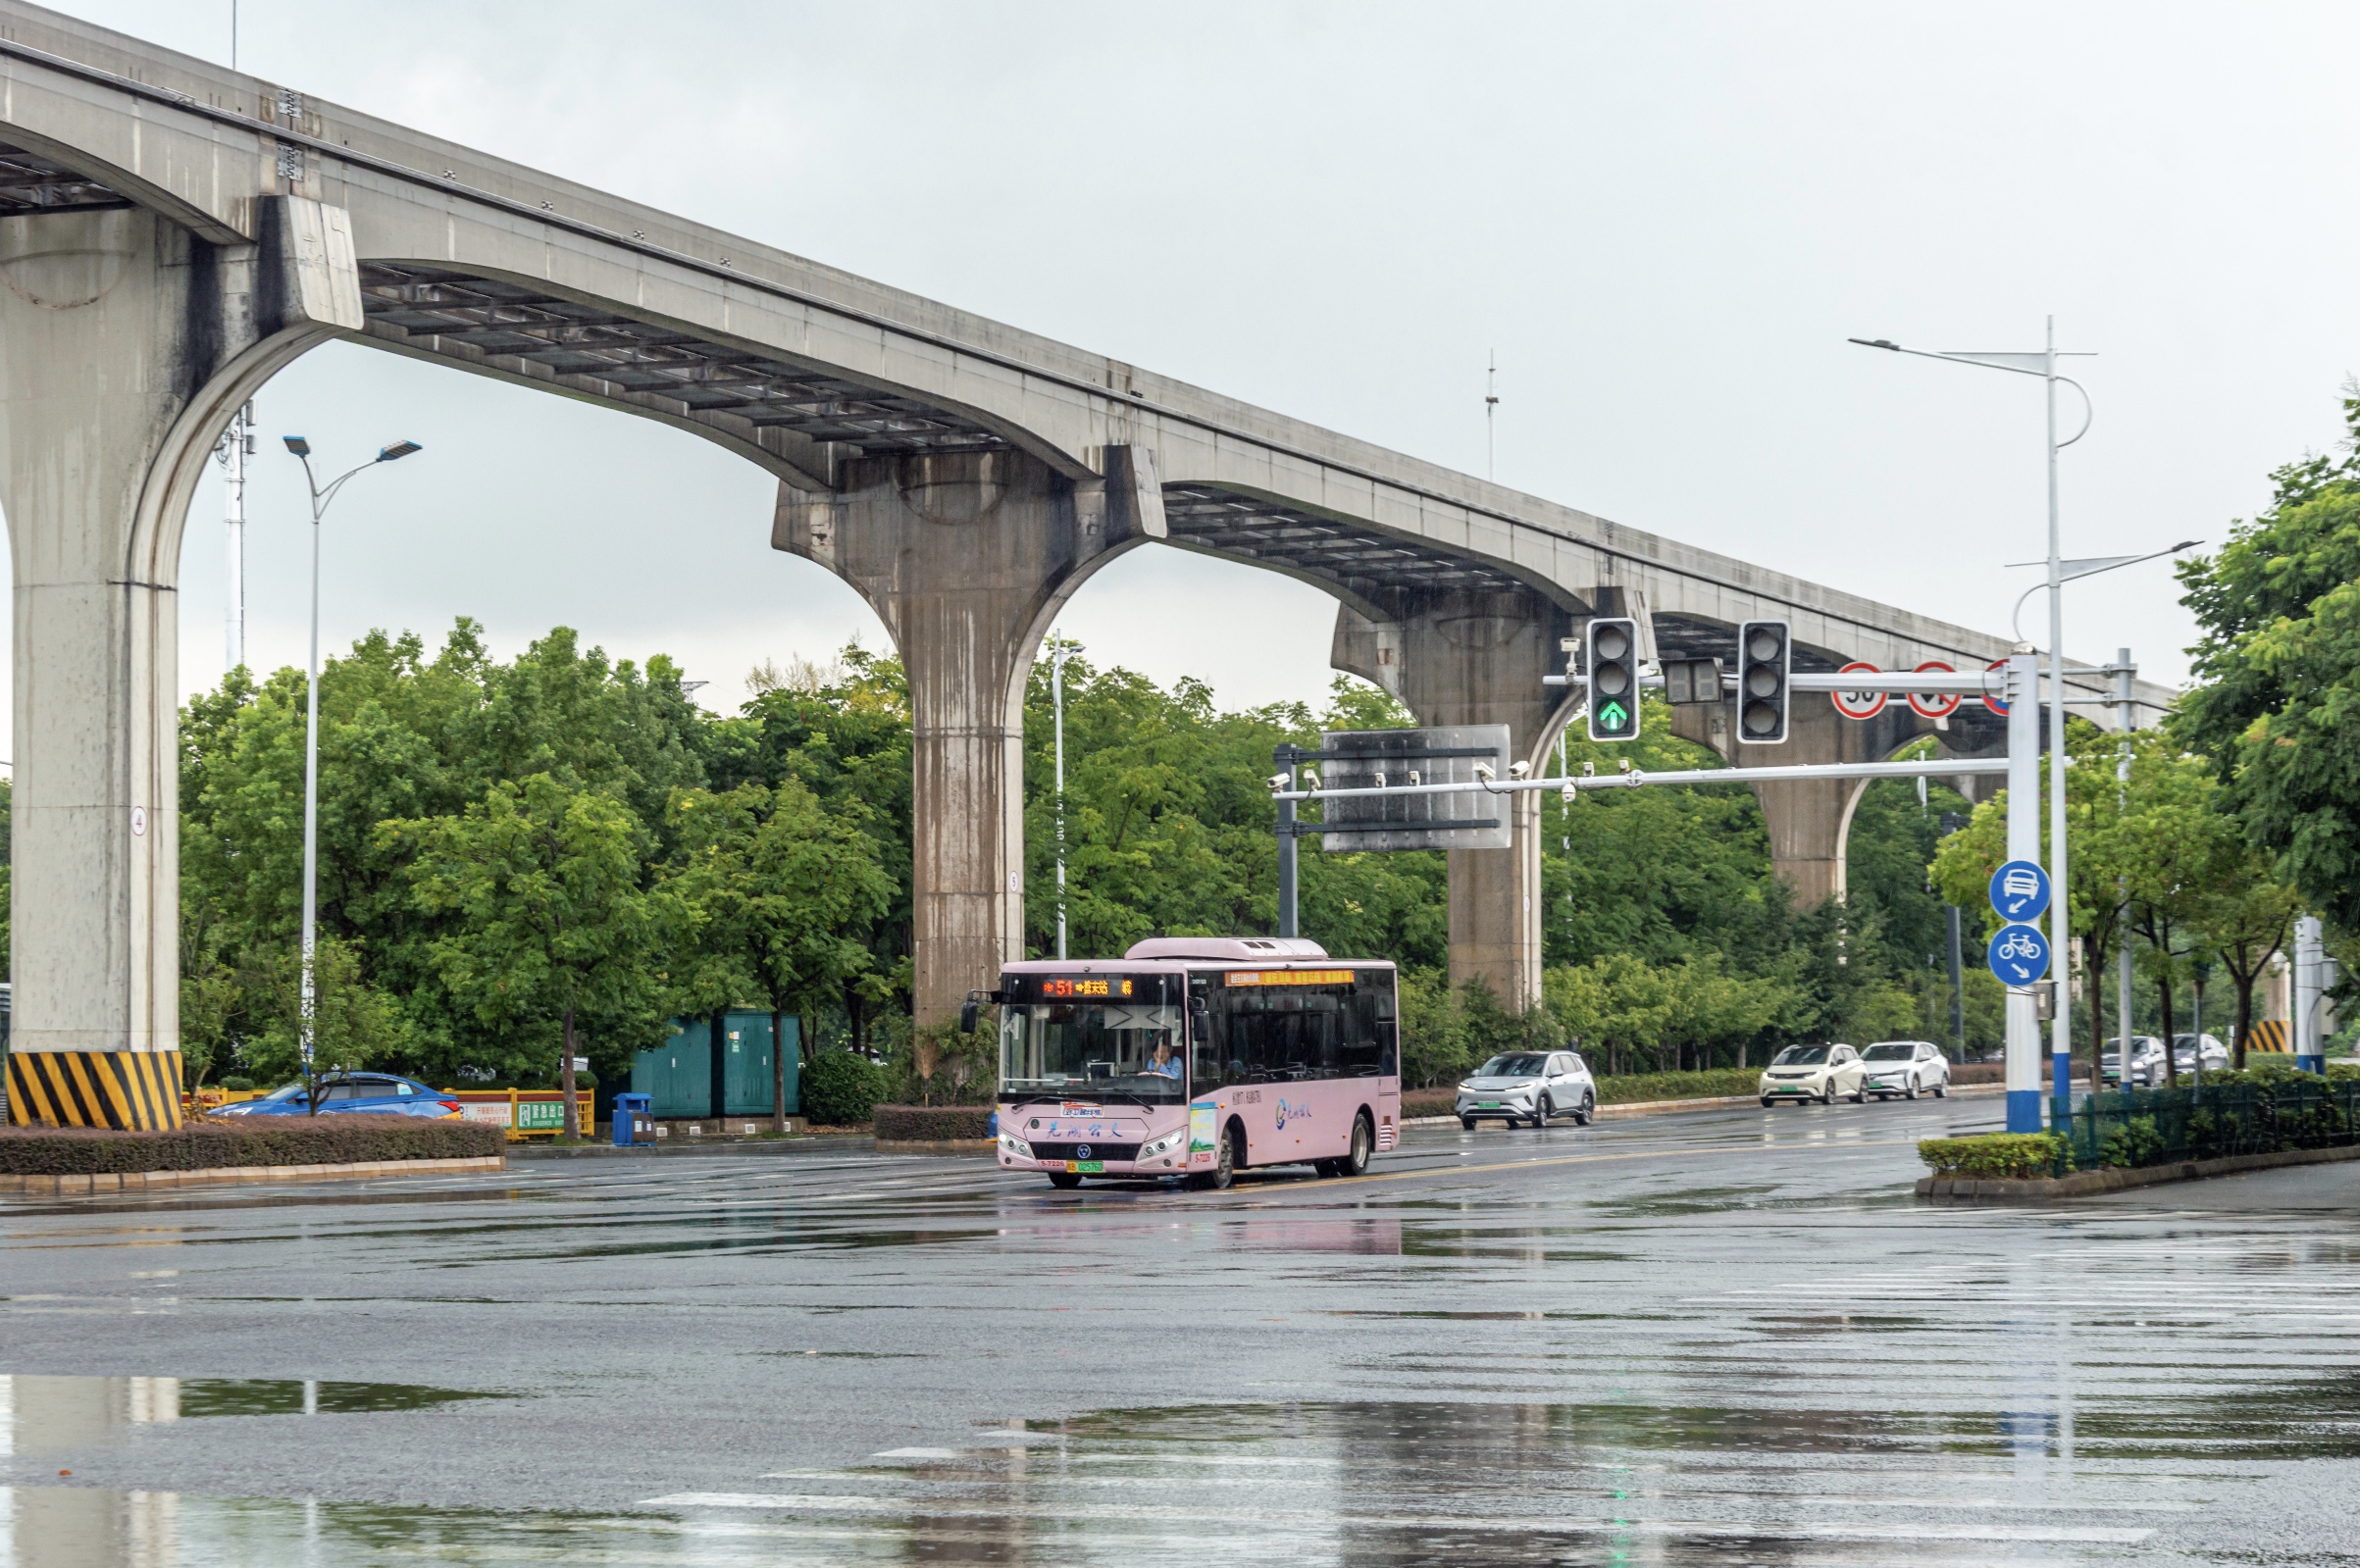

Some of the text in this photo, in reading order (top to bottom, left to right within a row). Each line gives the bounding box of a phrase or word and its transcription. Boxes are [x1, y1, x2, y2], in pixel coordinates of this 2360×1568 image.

[135, 815, 143, 829] 4
[1055, 979, 1073, 995] 51
[532, 1104, 564, 1119] 紧急出口
